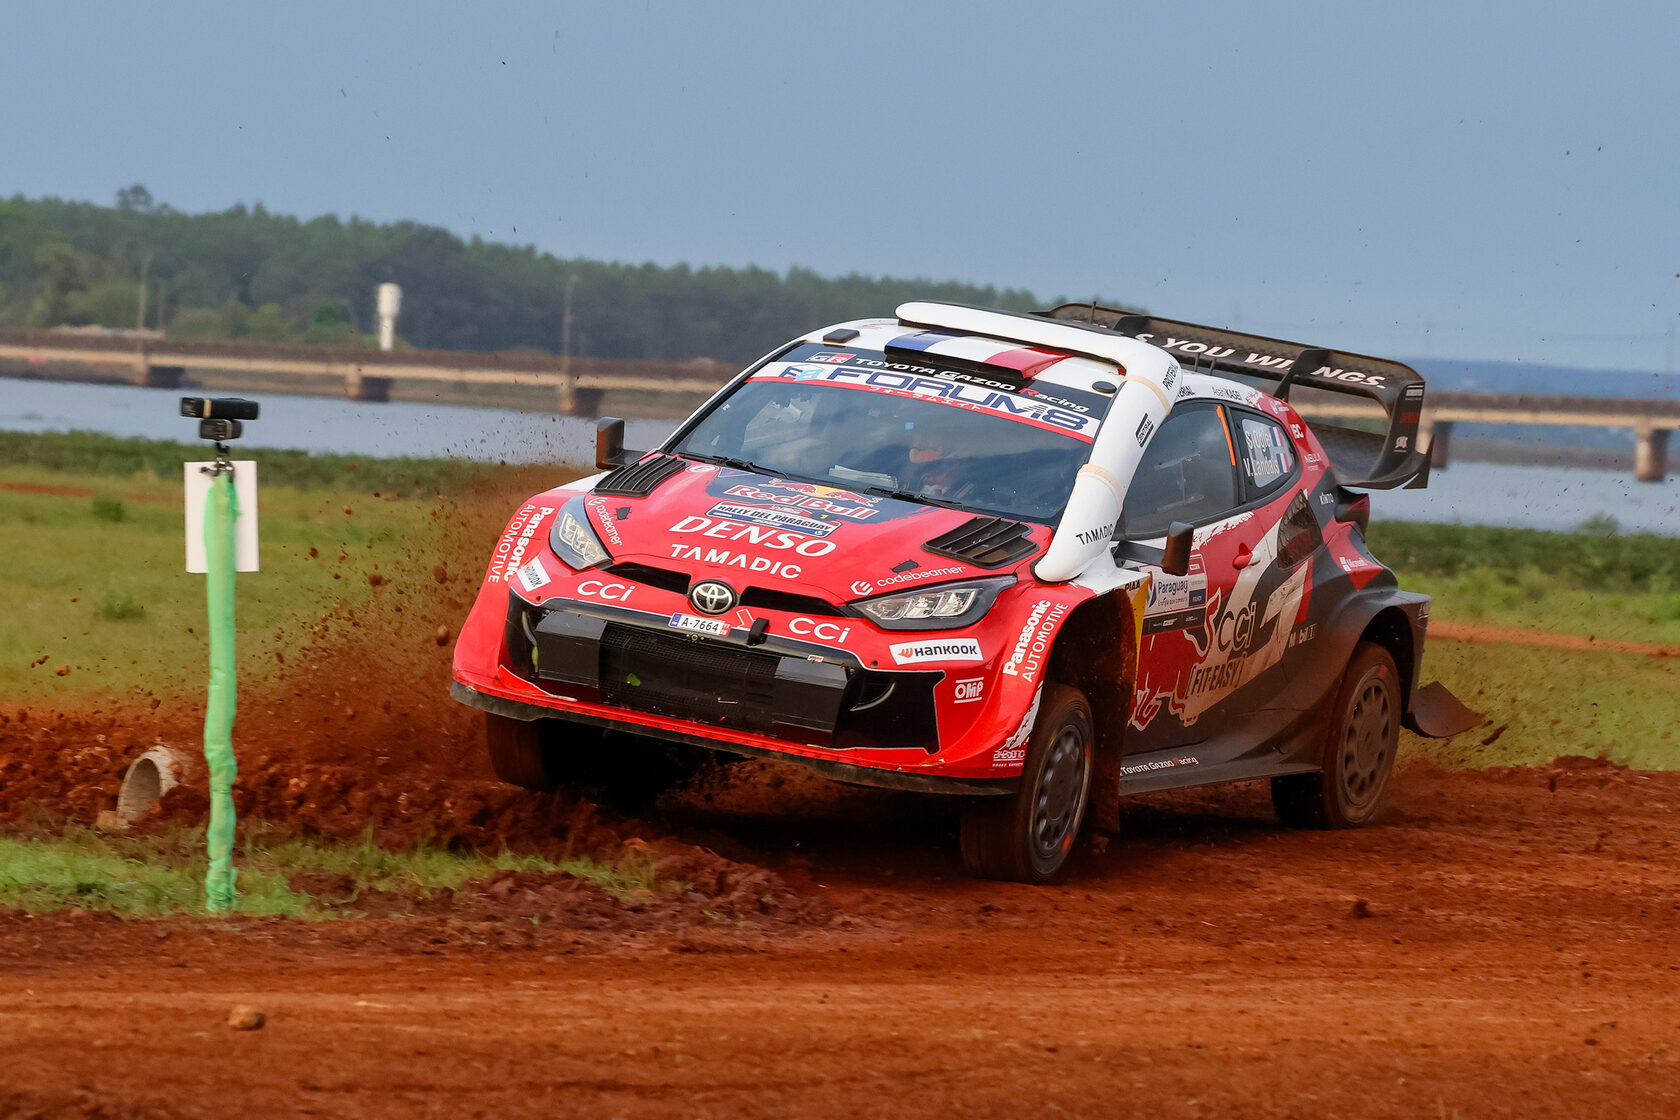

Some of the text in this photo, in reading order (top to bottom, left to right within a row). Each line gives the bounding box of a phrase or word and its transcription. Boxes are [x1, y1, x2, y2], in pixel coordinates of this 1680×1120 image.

[1162, 338, 1236, 357] YOU
[826, 367, 1089, 430] FORUM8
[856, 358, 936, 375] TOYOTA
[939, 370, 1017, 391] GAZOO
[1018, 388, 1090, 412] Racing
[717, 505, 751, 515] RALLY
[750, 510, 772, 520] DEL
[771, 514, 831, 530] PARAGUAY
[723, 484, 800, 504] Red
[799, 498, 880, 520] Bull
[488, 503, 536, 583] AUTOMOTIVE
[504, 506, 555, 582] Panasonic
[668, 515, 837, 557] DENSO
[670, 543, 802, 579] TAMADIC
[876, 566, 965, 588] codebeamer
[1158, 580, 1188, 596] Paraguay
[681, 616, 720, 633] A-7664
[1003, 600, 1052, 677] Panasonic
[1022, 602, 1069, 682] AUTOMOTIVE
[954, 680, 984, 699] OMP
[1120, 764, 1151, 775] TOYOTA
